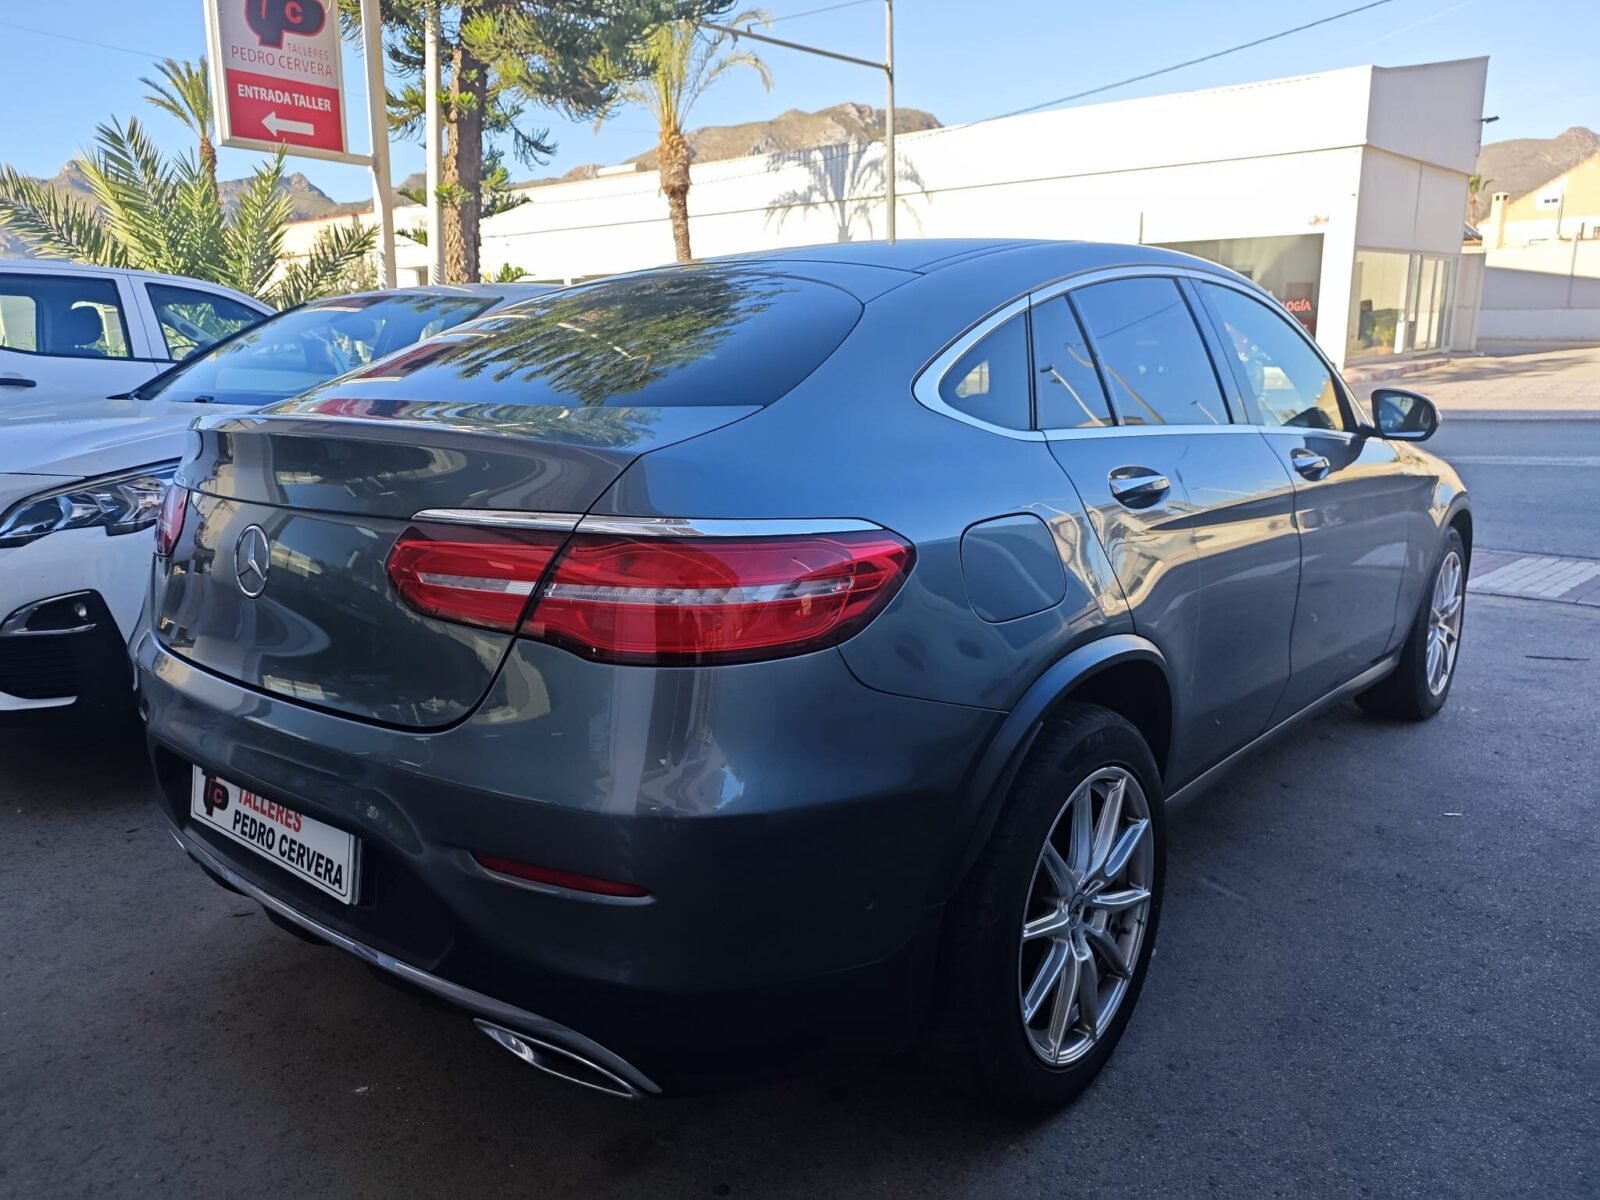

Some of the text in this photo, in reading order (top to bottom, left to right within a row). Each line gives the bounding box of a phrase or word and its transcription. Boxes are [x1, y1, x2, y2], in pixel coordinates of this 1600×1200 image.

[231, 45, 333, 77] PEDRO CERVERA
[287, 43, 329, 61] TALLERES
[237, 83, 332, 112] ENTRADA TALLER
[1282, 299, 1311, 312] OGÍA
[238, 788, 302, 833] TALLERES
[232, 809, 343, 889] PEDRO CERVERA
